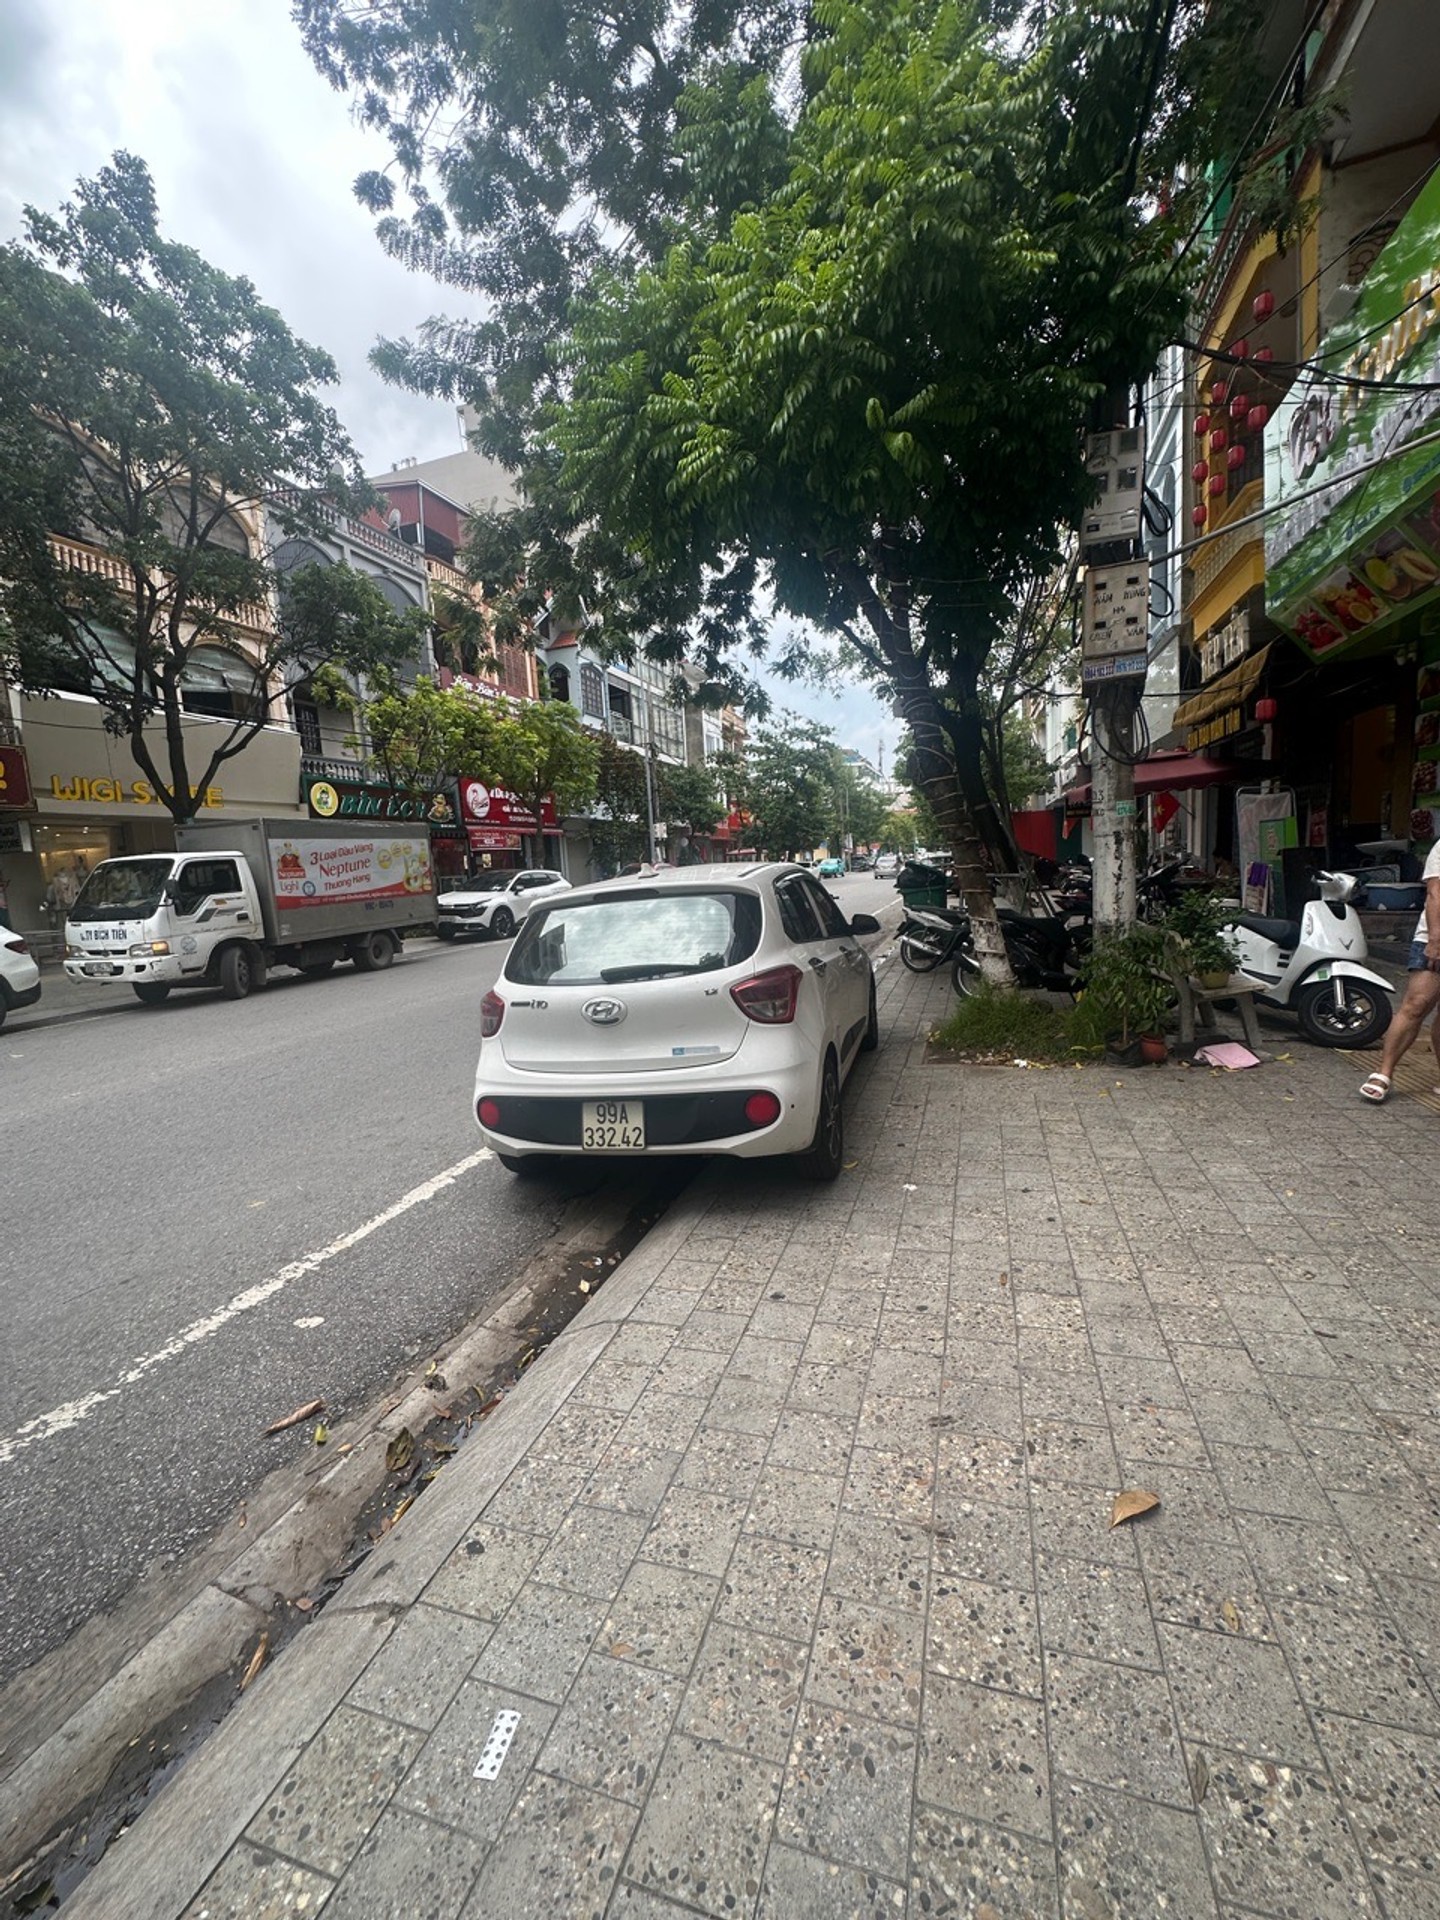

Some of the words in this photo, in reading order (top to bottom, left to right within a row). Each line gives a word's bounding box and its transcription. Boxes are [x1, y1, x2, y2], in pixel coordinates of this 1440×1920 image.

[51, 774, 122, 803] WIGI
[310, 851, 318, 865] 3
[319, 857, 371, 879] Neptune
[596, 1103, 629, 1124] 99A
[584, 1126, 643, 1148] 332.42
